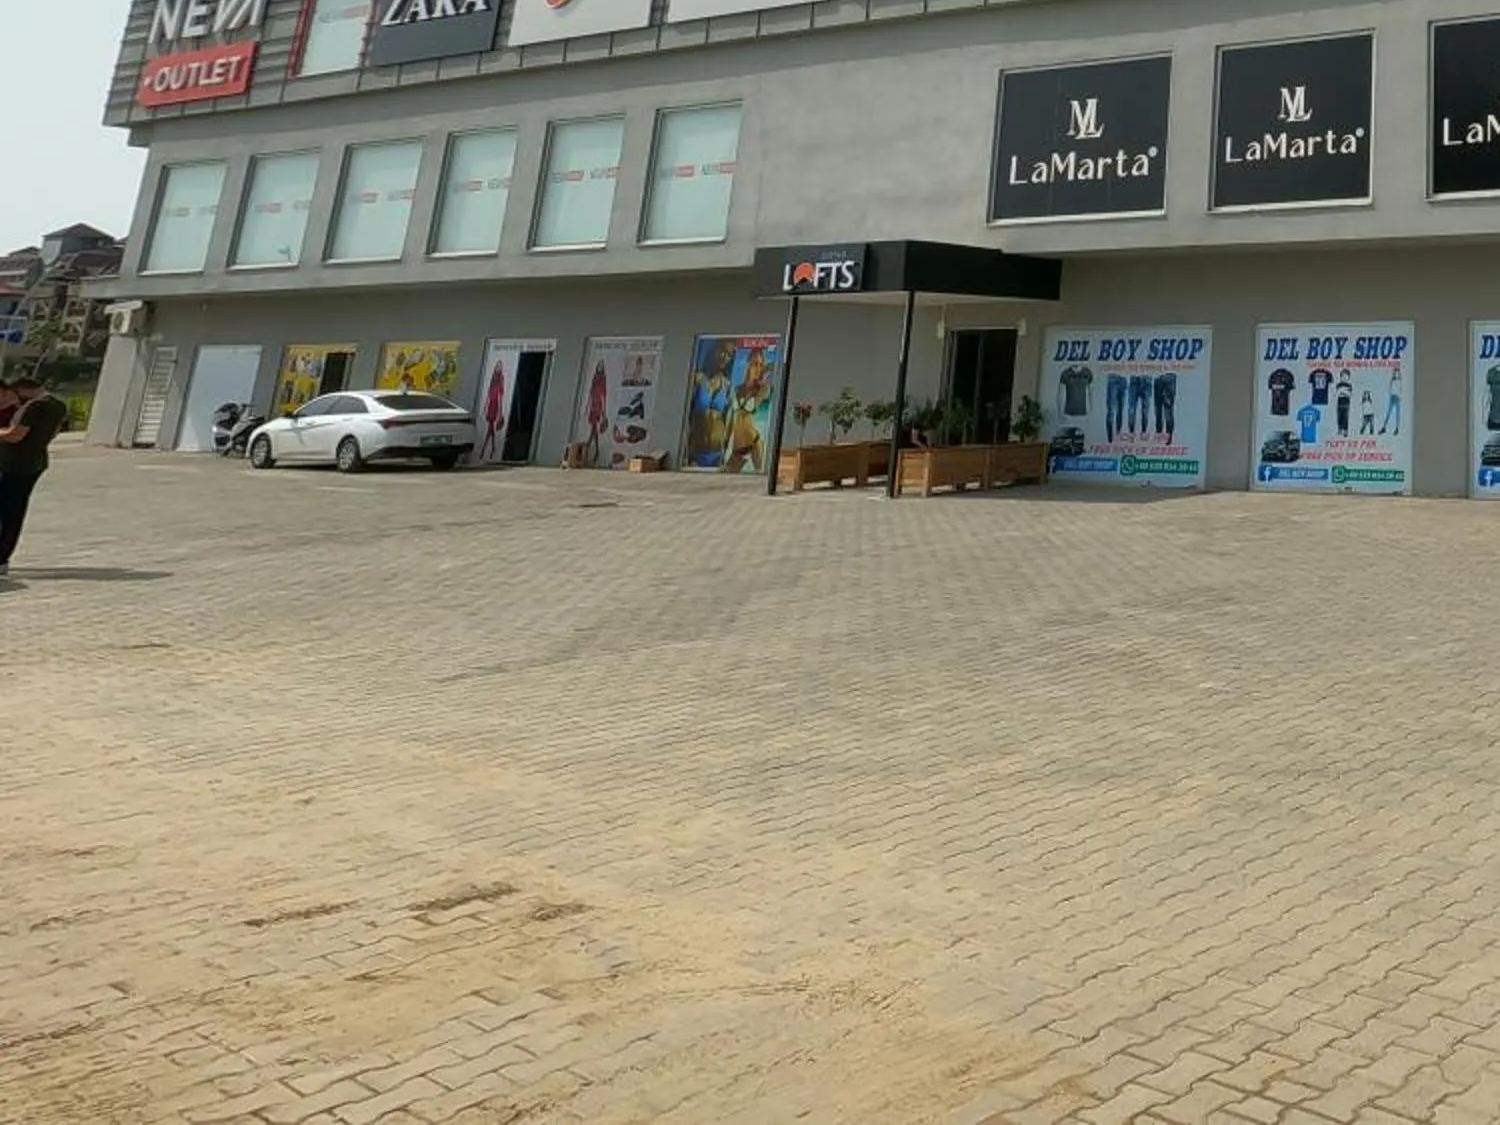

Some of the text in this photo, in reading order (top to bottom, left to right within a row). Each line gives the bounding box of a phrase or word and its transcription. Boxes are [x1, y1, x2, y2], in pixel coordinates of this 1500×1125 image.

[154, 55, 241, 92] OUTLET
[1225, 131, 1357, 162] LaMarta
[1009, 149, 1149, 185] LaMarta
[782, 260, 855, 291] LOFTS
[1054, 338, 1203, 361] DEL BOY SHOP
[1264, 336, 1407, 360] DEL BOY SHOP
